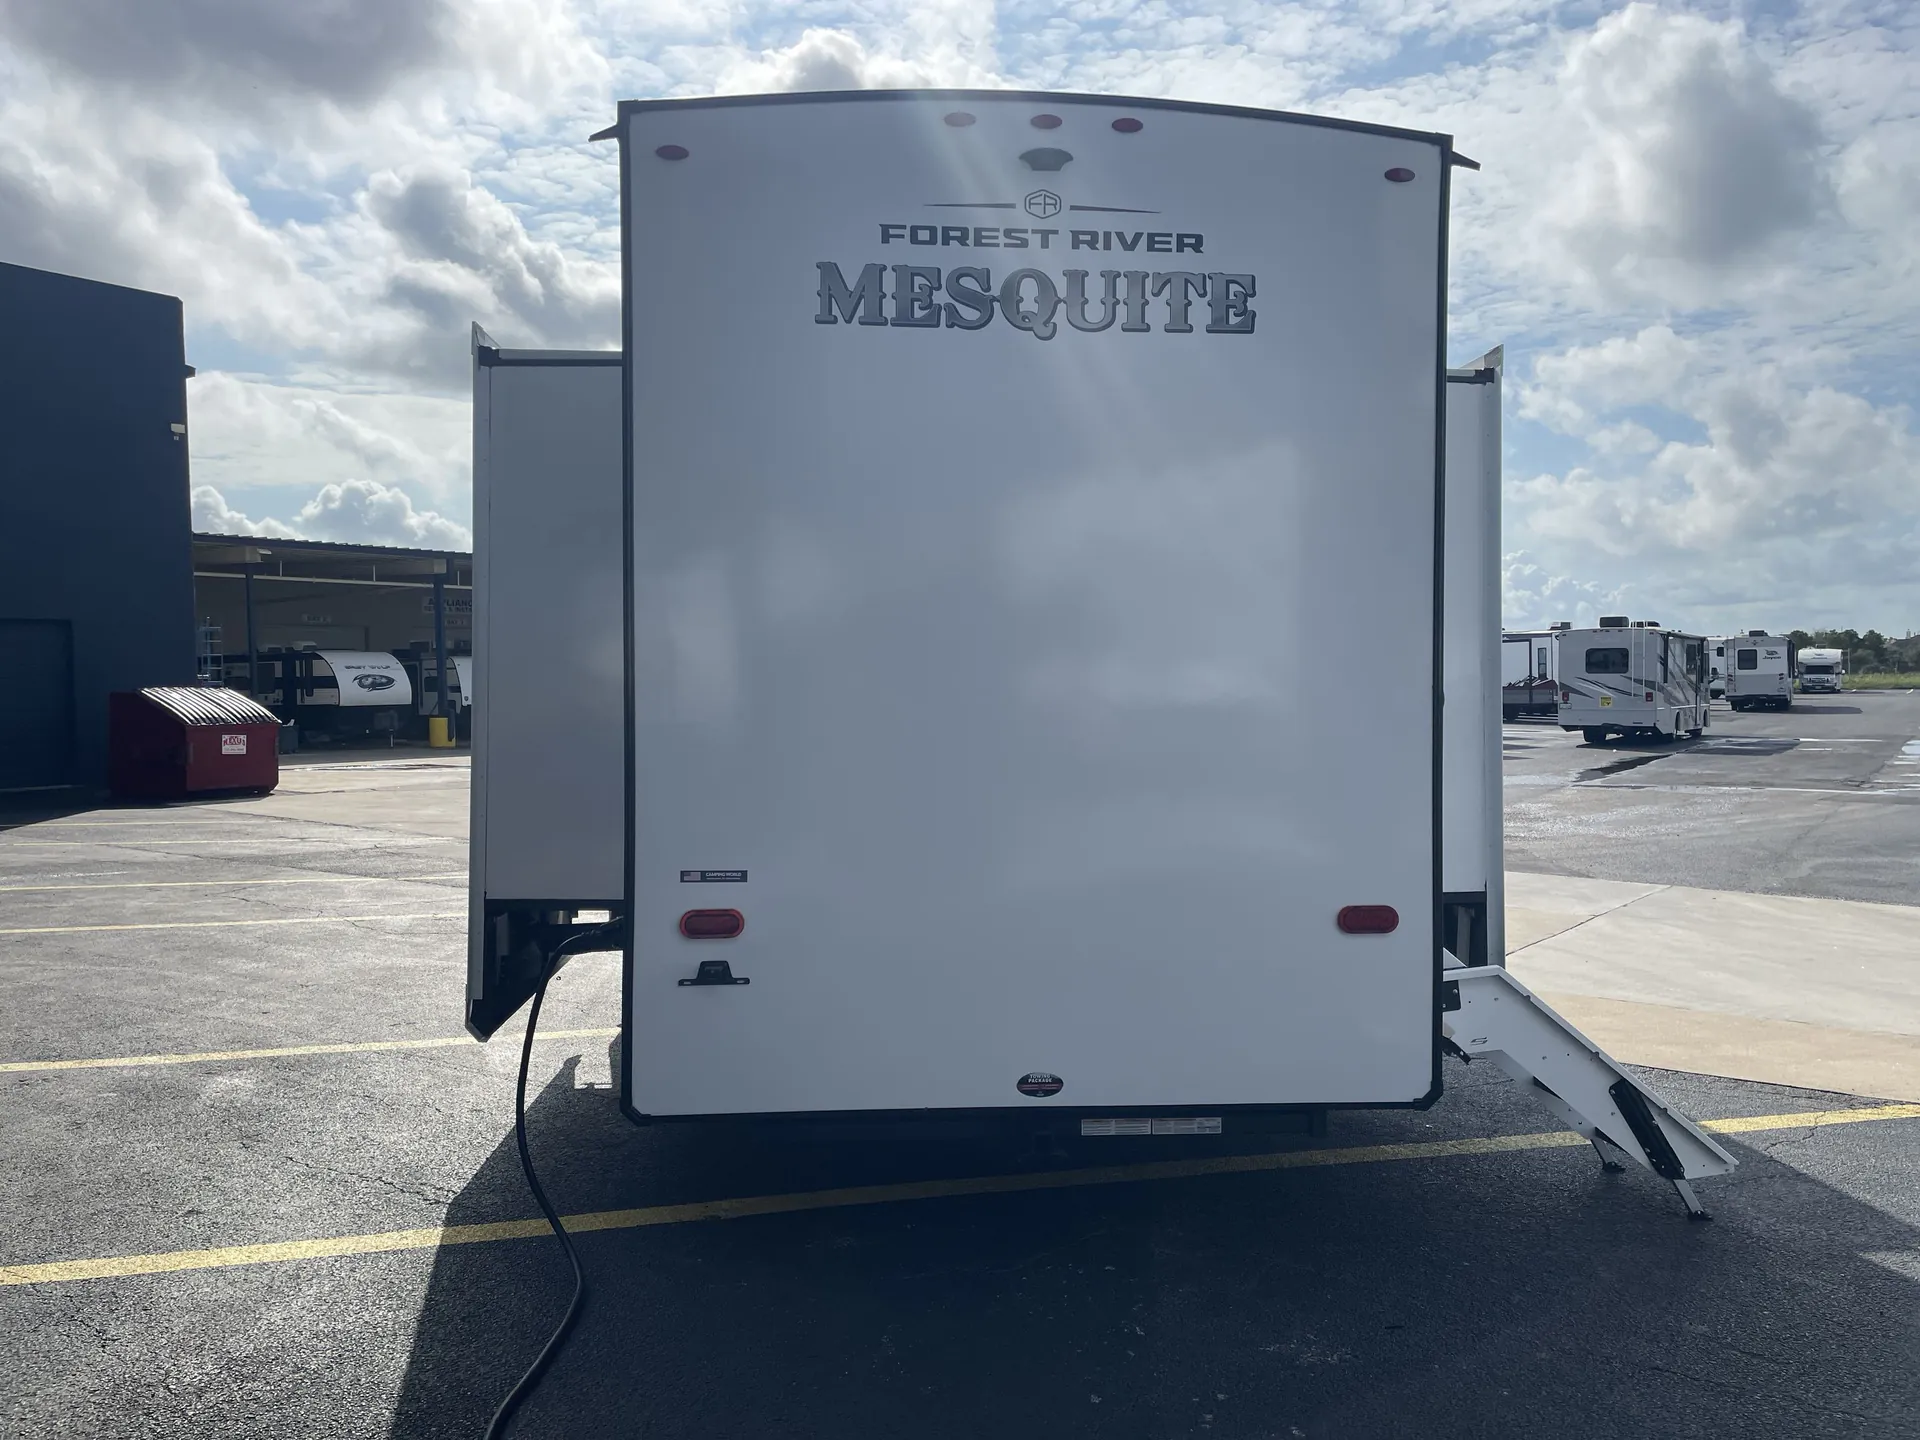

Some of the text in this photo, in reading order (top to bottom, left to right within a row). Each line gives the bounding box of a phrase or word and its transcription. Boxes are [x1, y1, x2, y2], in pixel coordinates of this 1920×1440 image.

[878, 223, 1205, 254] FOREST RIVER
[814, 261, 1257, 341] MESQUITE
